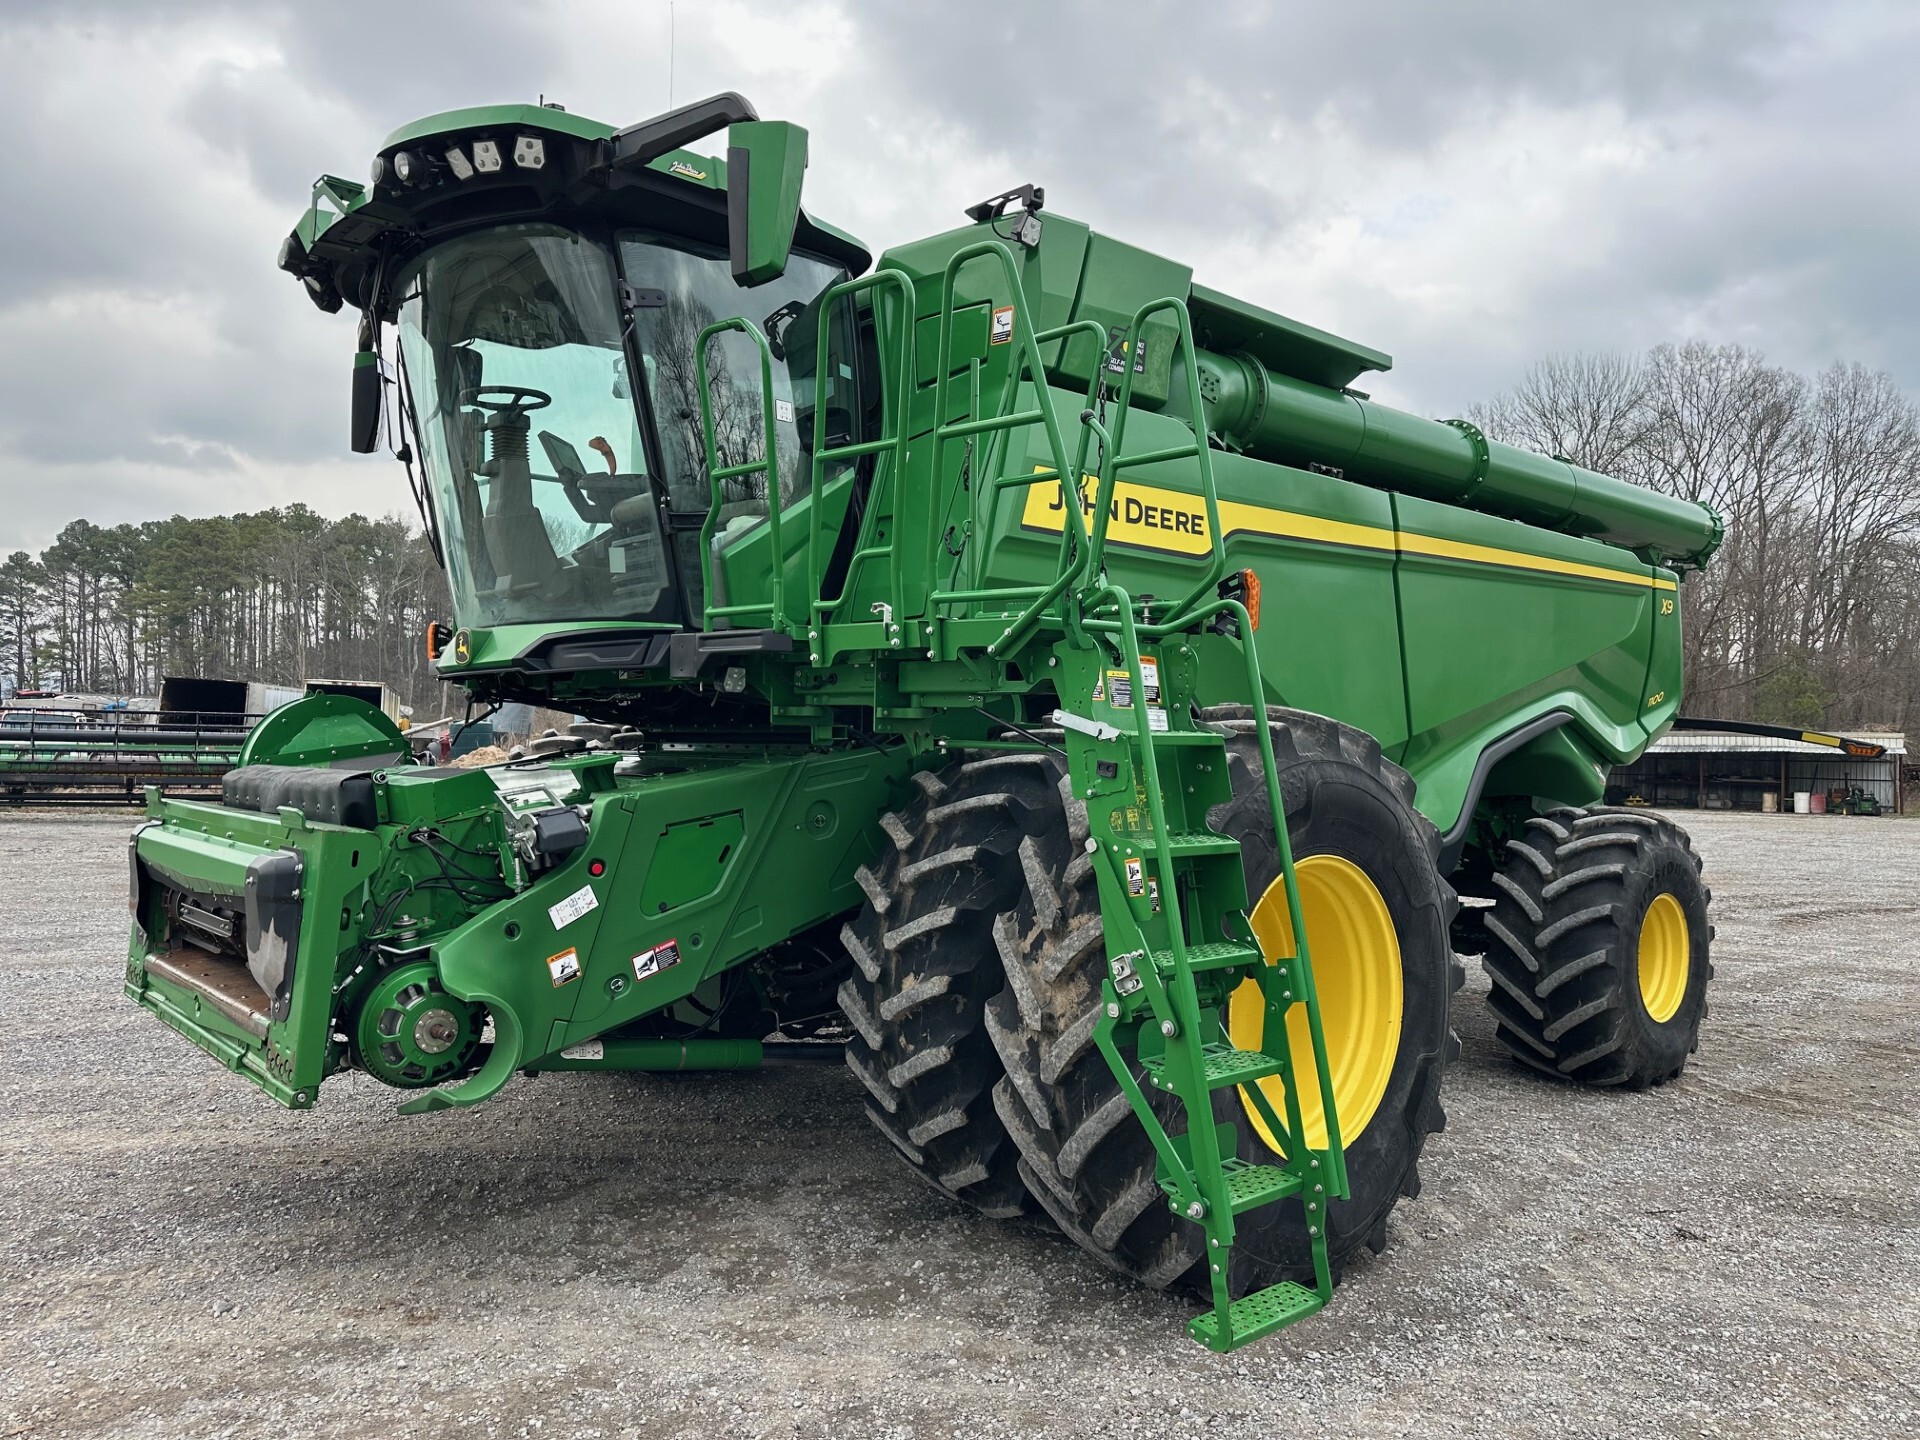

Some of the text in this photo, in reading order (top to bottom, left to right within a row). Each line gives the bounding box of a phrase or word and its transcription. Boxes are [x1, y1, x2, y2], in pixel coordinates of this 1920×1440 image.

[1049, 483, 1205, 536] JHN DEERE
[1660, 598, 1674, 616] X9
